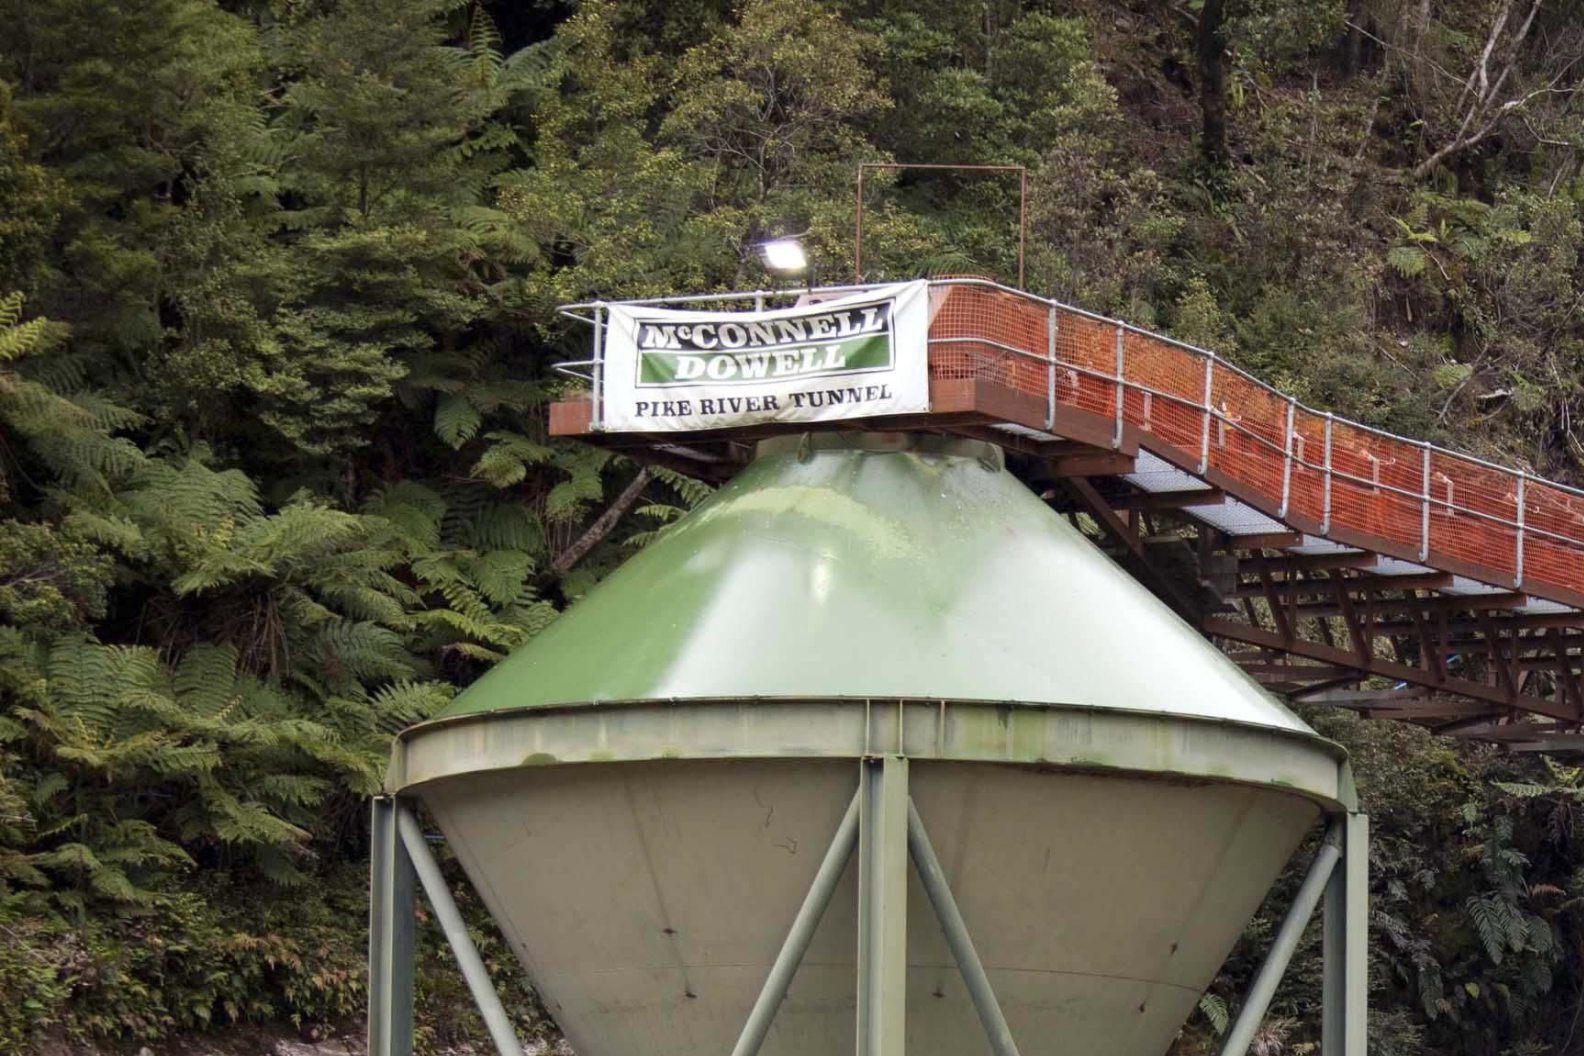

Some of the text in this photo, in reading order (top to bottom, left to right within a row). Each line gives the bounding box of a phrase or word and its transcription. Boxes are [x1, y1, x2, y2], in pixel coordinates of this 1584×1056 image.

[641, 308, 883, 349] McCONNELL
[674, 345, 847, 381] DOWELL
[634, 384, 893, 418] PIKE RIVER TUNNEL
